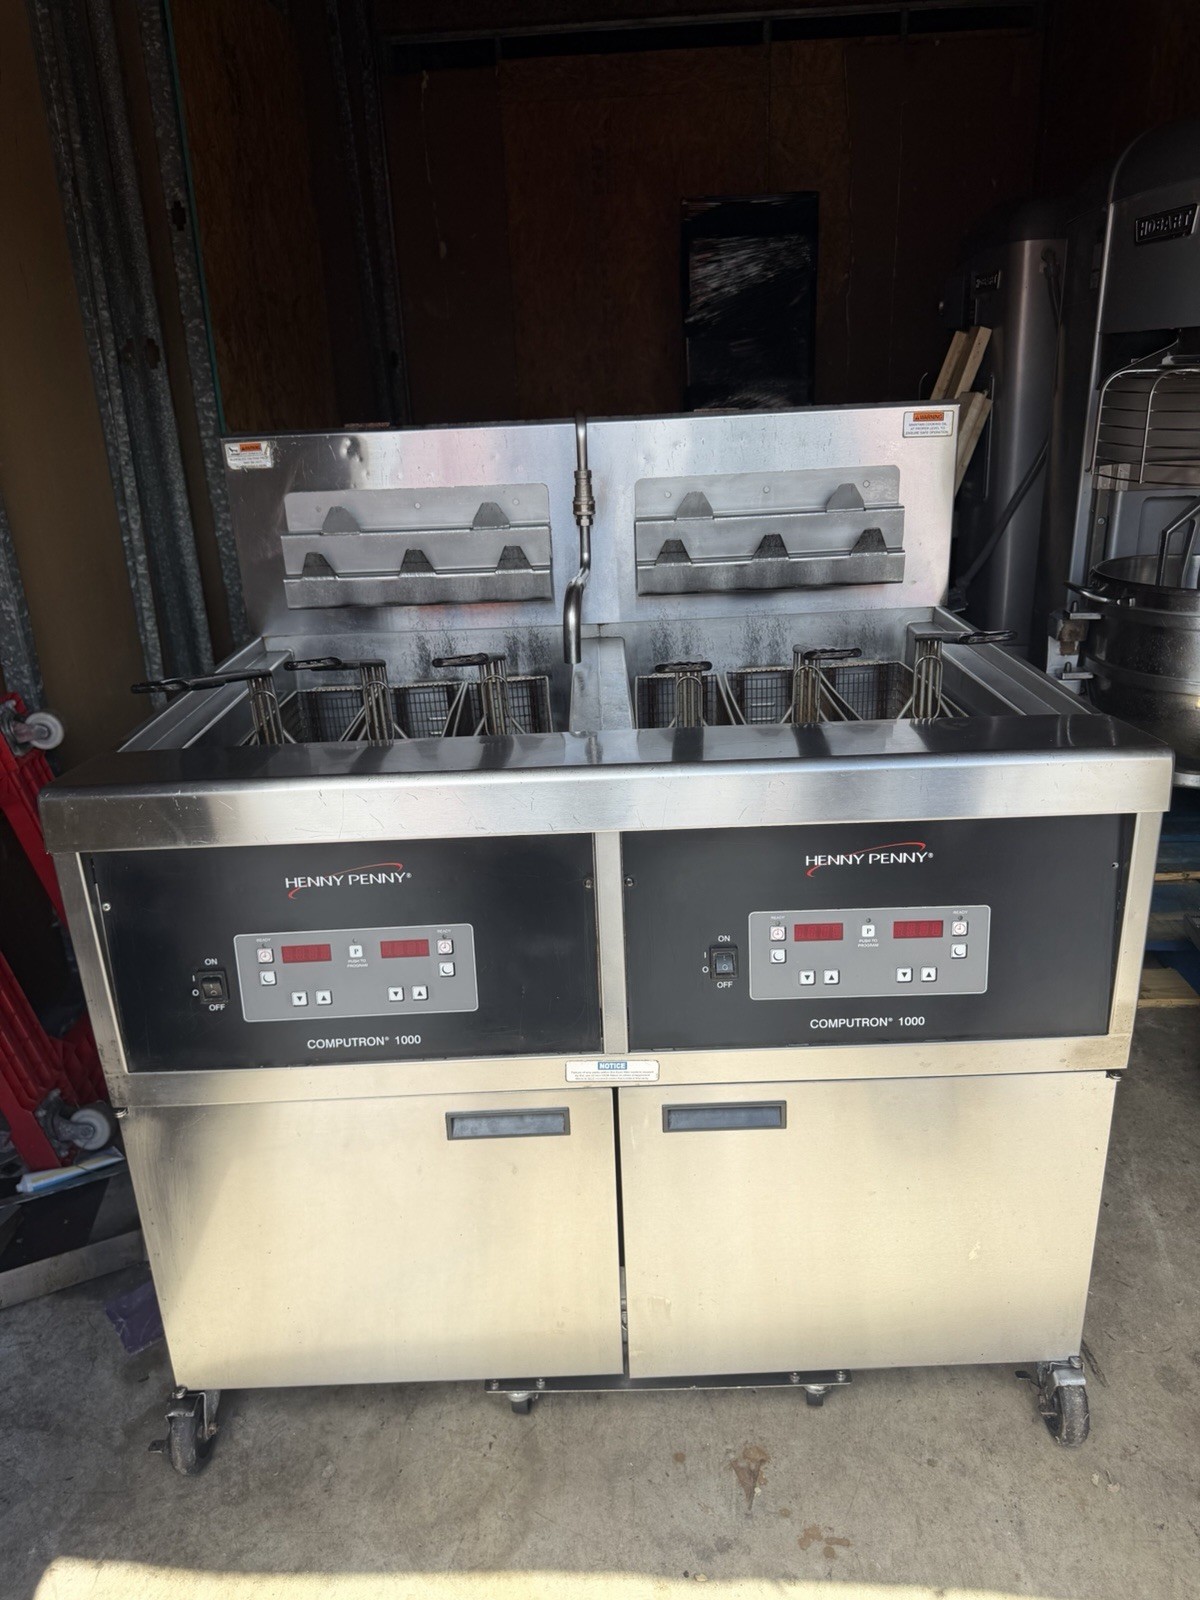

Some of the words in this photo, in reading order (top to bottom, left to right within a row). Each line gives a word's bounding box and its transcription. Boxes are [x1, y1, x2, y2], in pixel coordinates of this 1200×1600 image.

[1139, 209, 1192, 237] HOBART
[805, 854, 865, 866] HENNY
[285, 875, 344, 888] HENNY
[717, 934, 731, 943] ON
[204, 957, 218, 966] ON
[716, 980, 733, 989] OFF
[208, 1003, 226, 1012] OFF
[898, 1016, 926, 1026] 1000
[394, 1034, 422, 1045] 1000
